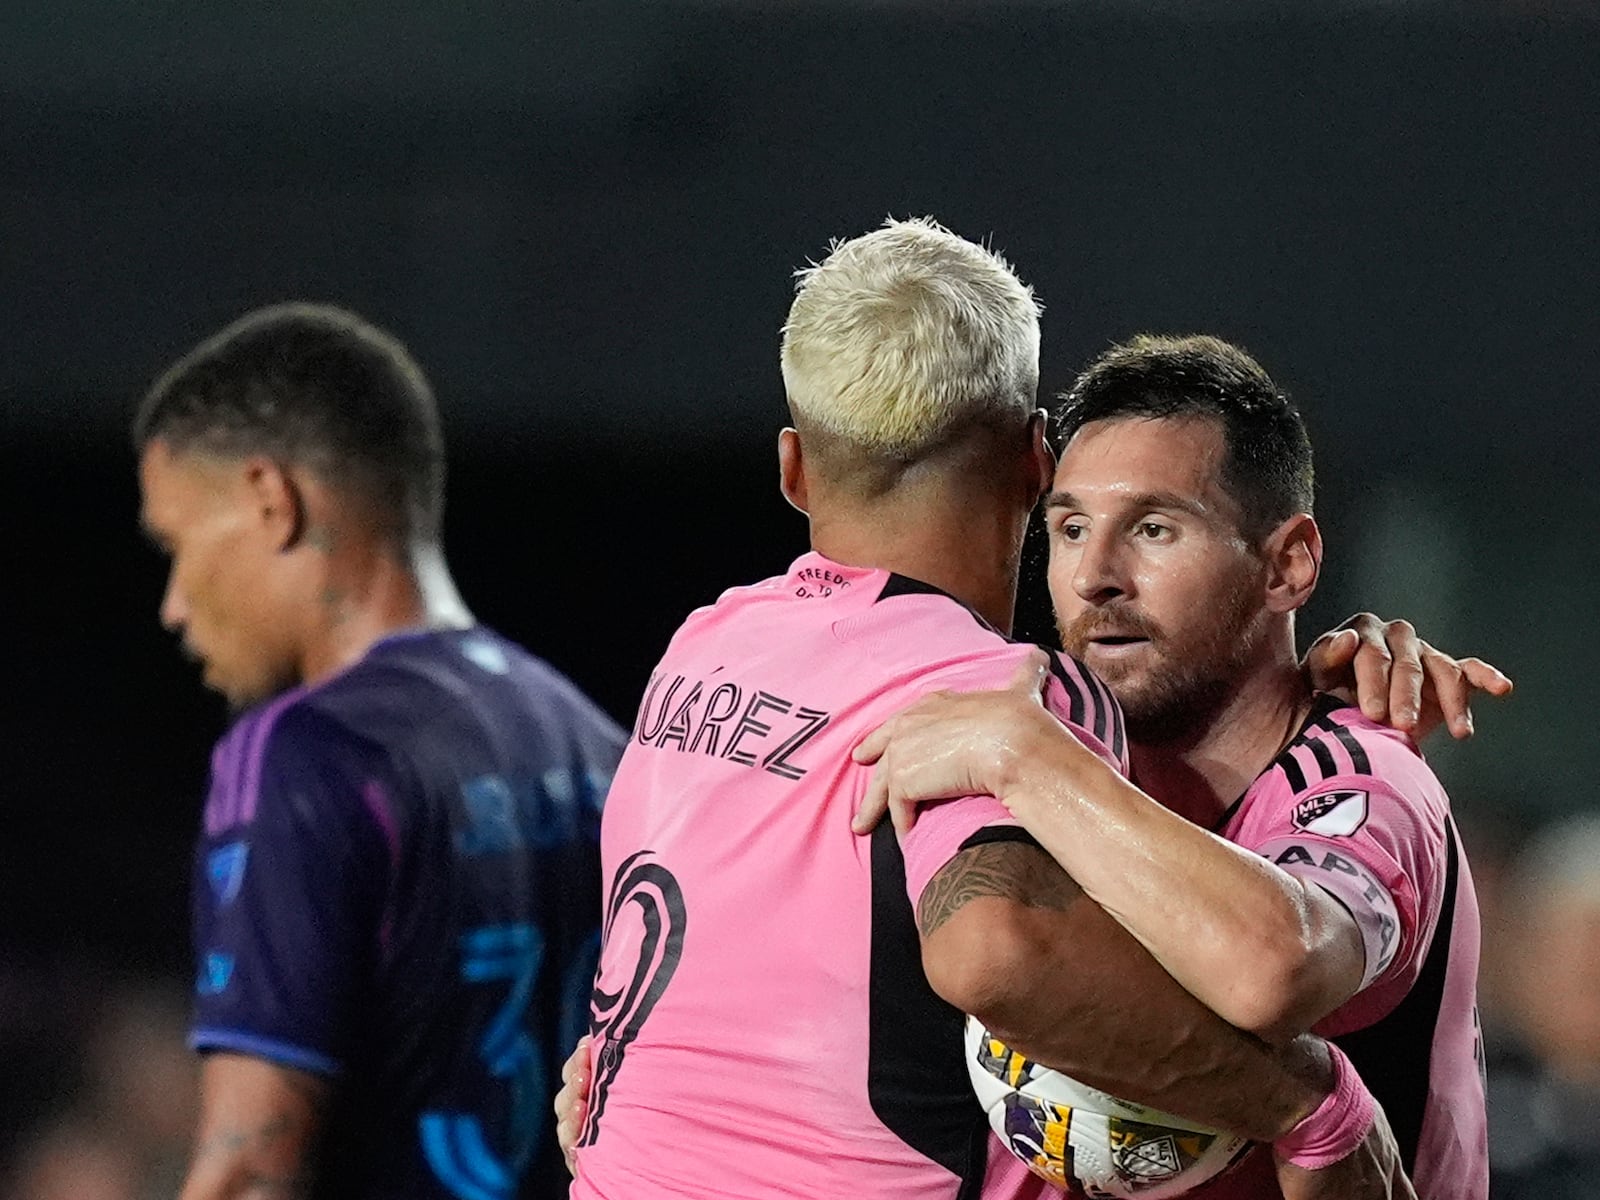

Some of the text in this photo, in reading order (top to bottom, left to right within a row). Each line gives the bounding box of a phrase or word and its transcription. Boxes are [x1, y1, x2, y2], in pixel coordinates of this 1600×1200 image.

[630, 666, 831, 781] UÁREZ
[1299, 795, 1337, 816] MLS
[576, 850, 688, 1147] 9
